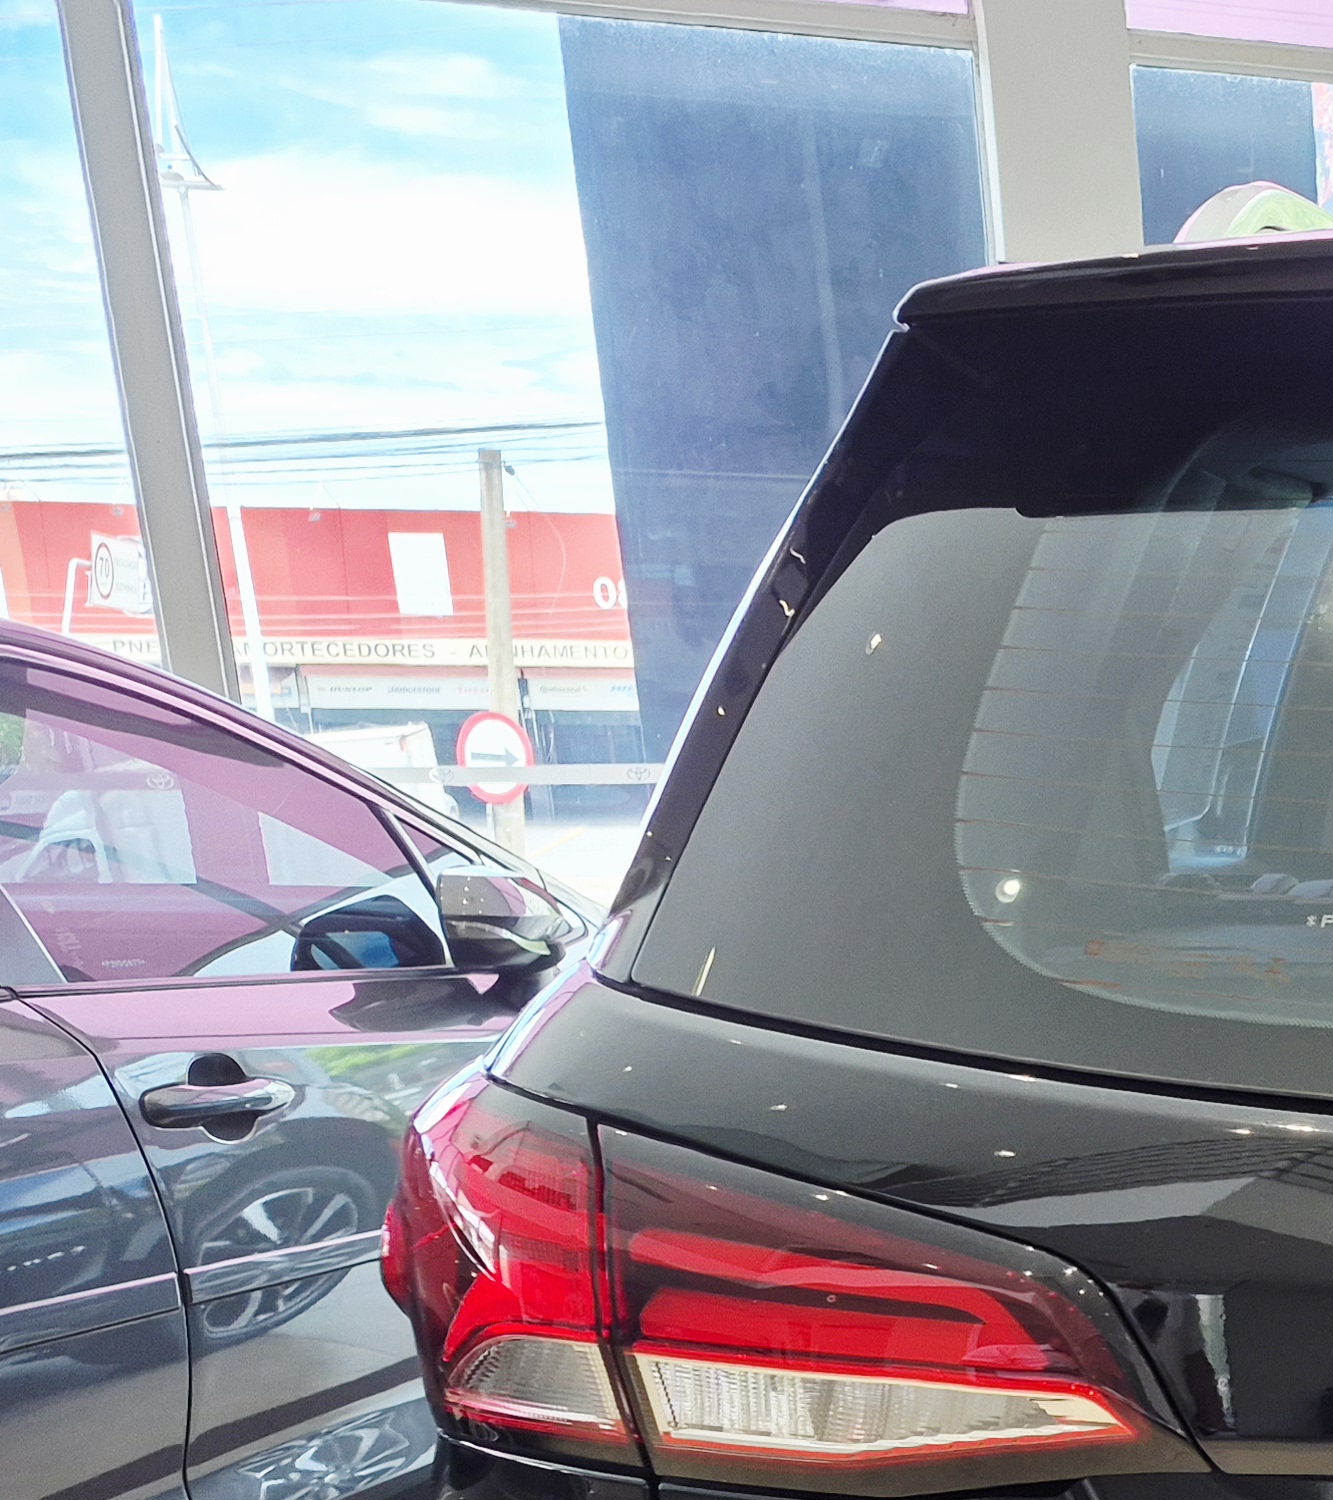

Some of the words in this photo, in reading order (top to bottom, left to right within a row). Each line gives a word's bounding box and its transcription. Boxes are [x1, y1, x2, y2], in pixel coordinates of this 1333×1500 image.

[99, 556, 110, 579] 70
[112, 639, 158, 653] PNE
[468, 643, 628, 660] AHAMENTO
